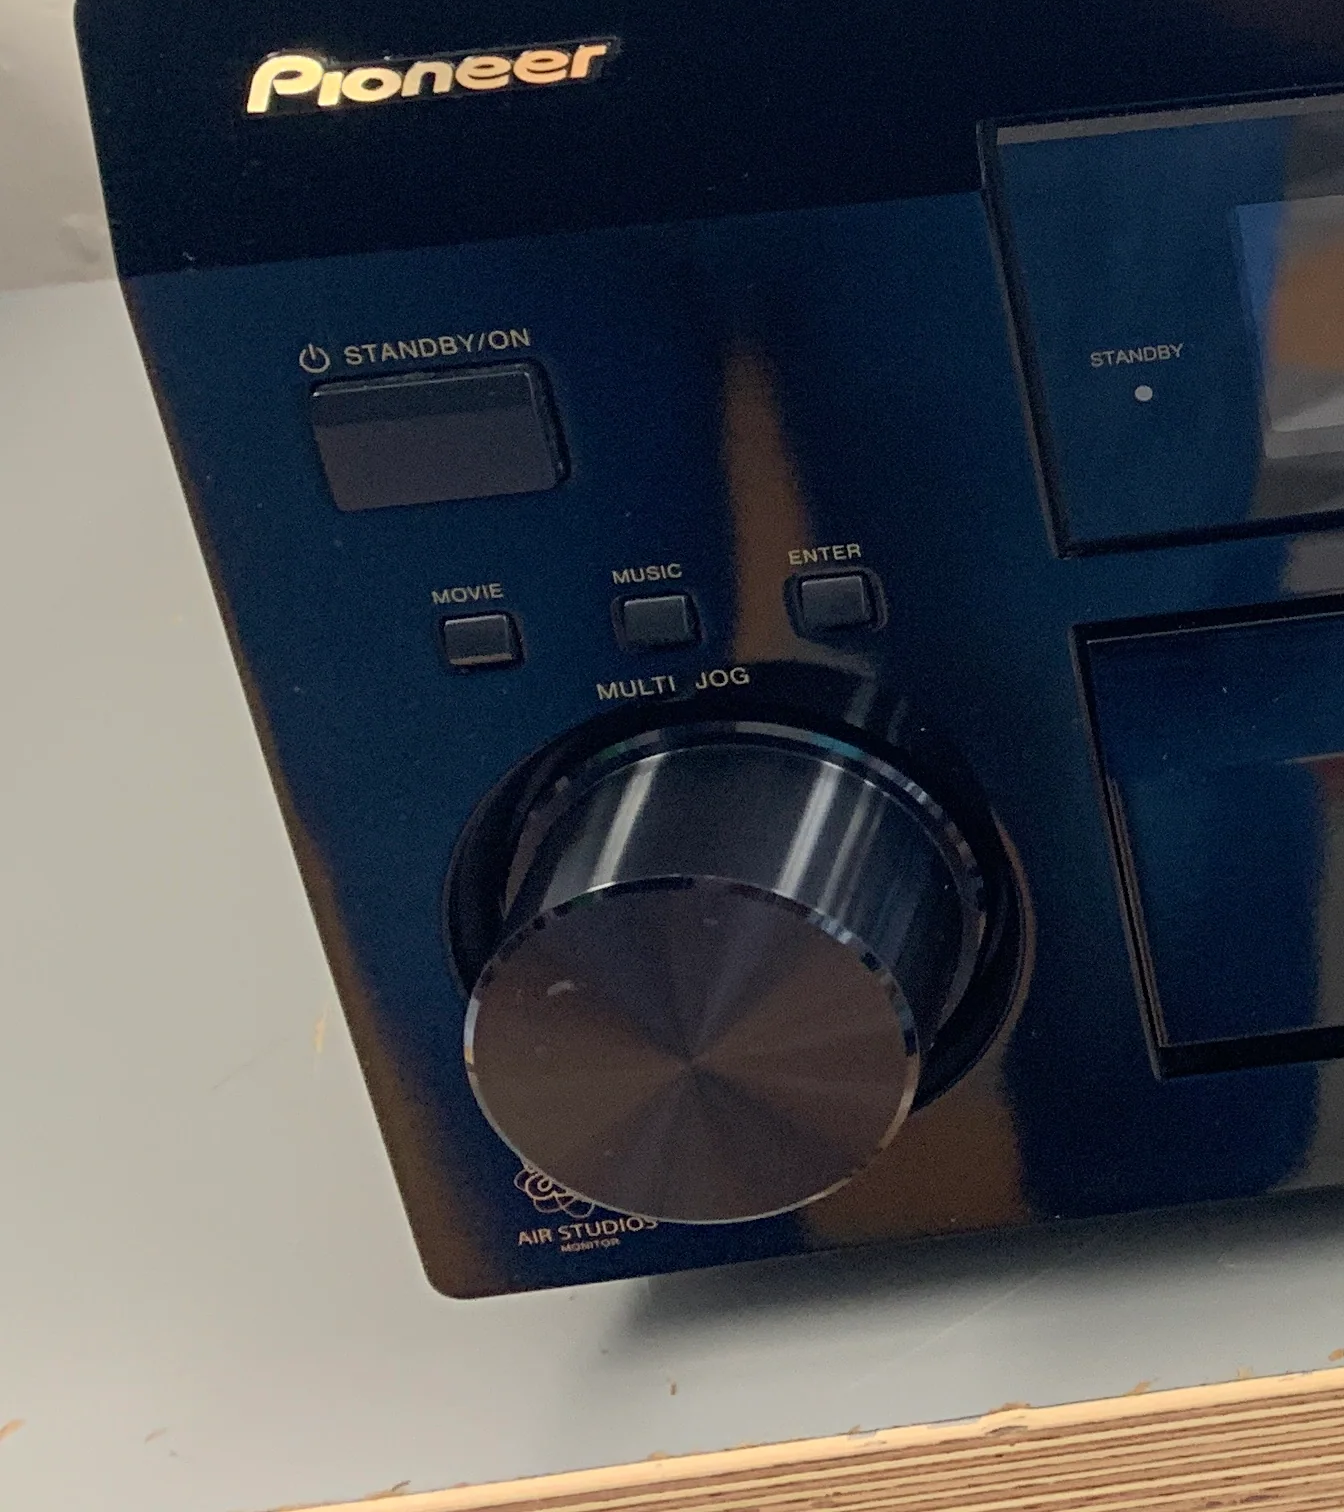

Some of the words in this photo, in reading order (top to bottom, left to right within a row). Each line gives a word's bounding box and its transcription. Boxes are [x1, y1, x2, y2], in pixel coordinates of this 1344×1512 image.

[246, 41, 608, 114] Pioneer
[343, 326, 533, 367] STANDBY/ON
[1090, 340, 1185, 369] STANDBY
[787, 542, 863, 567] ENTER
[612, 562, 683, 586] MUSIC
[431, 581, 505, 606] MOVIE
[596, 674, 676, 701] MULTI
[695, 664, 751, 690] JOG
[517, 1228, 553, 1246] AIR
[557, 1216, 659, 1241] STUDIOS
[560, 1236, 621, 1253] MONITOR
